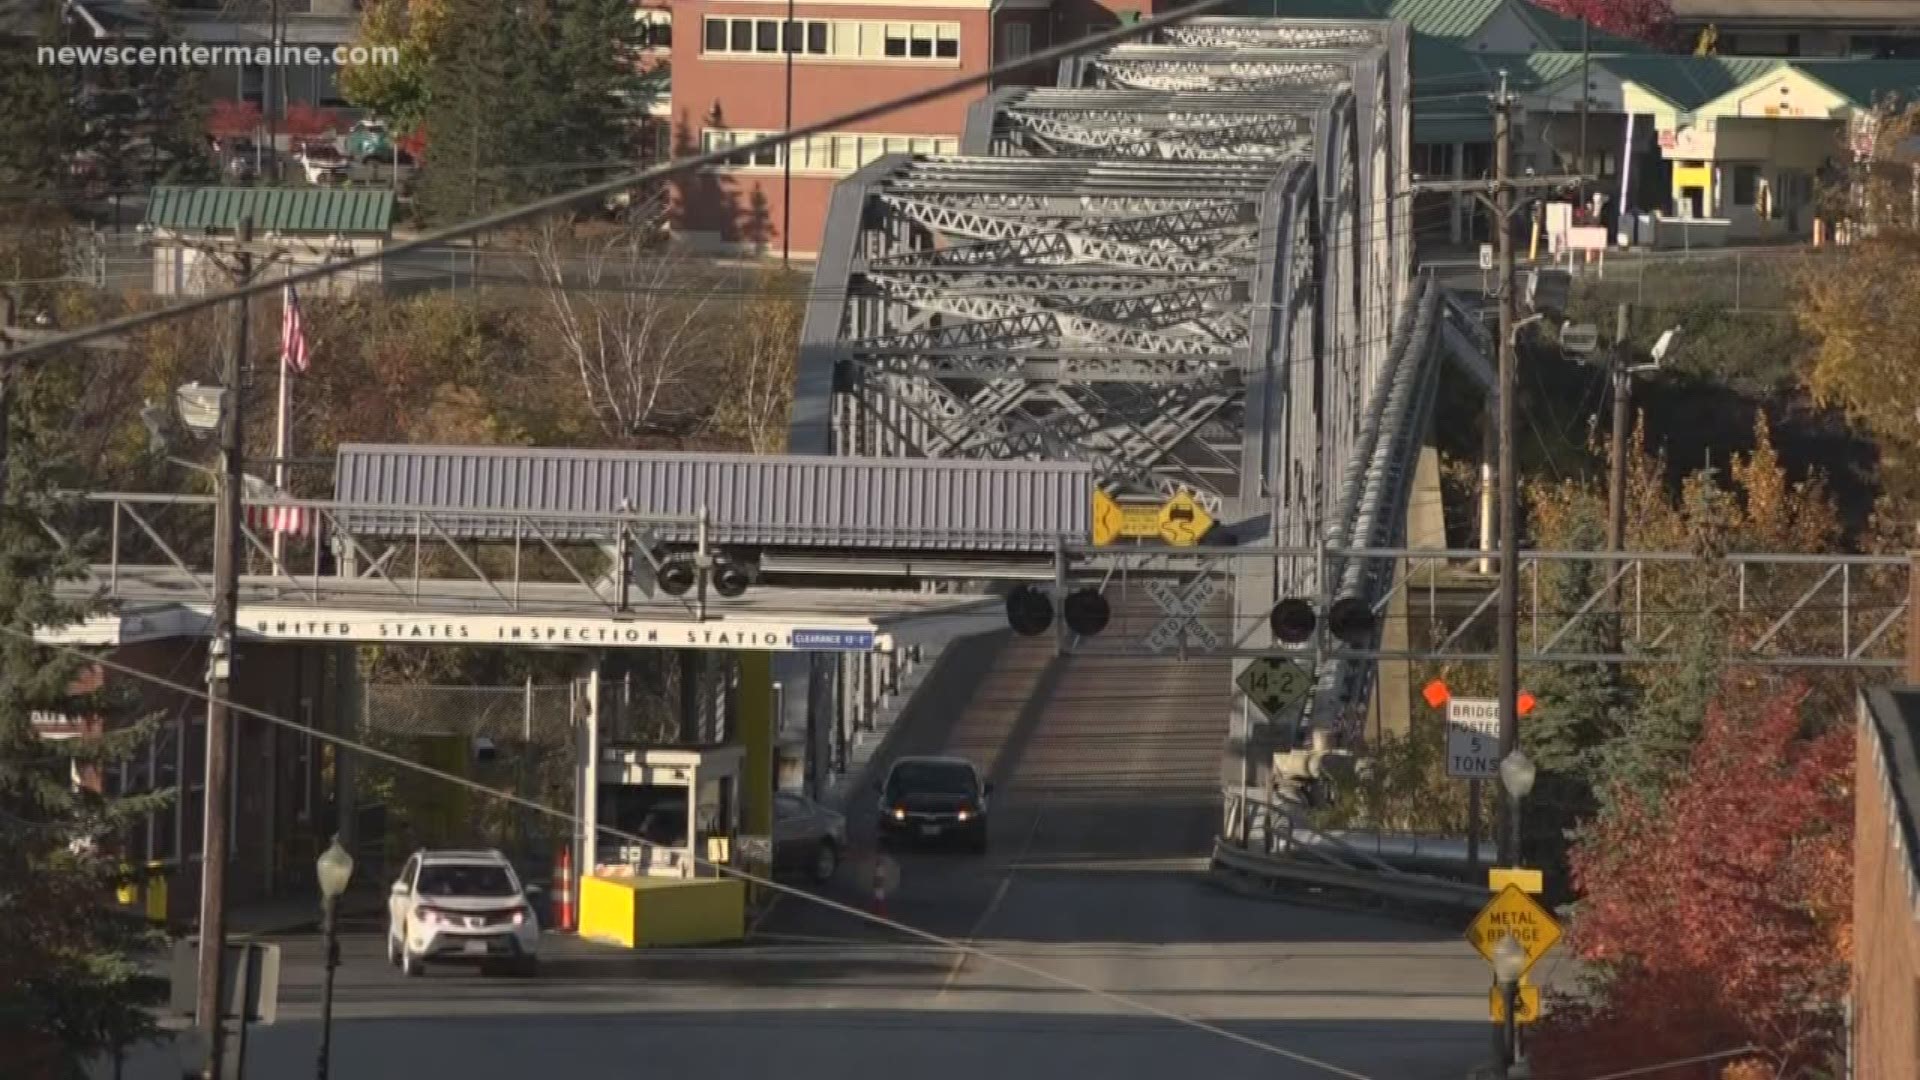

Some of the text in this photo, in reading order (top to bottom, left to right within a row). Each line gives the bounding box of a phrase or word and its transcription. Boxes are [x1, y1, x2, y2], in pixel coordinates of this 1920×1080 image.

[258, 620, 350, 634] UNITED
[379, 624, 468, 637] STATES
[499, 626, 657, 642] INSPECTION
[1452, 705, 1501, 718] BRIDGE
[1471, 736, 1482, 753] 5
[1454, 756, 1500, 771] TONS
[1490, 912, 1537, 925] METAL
